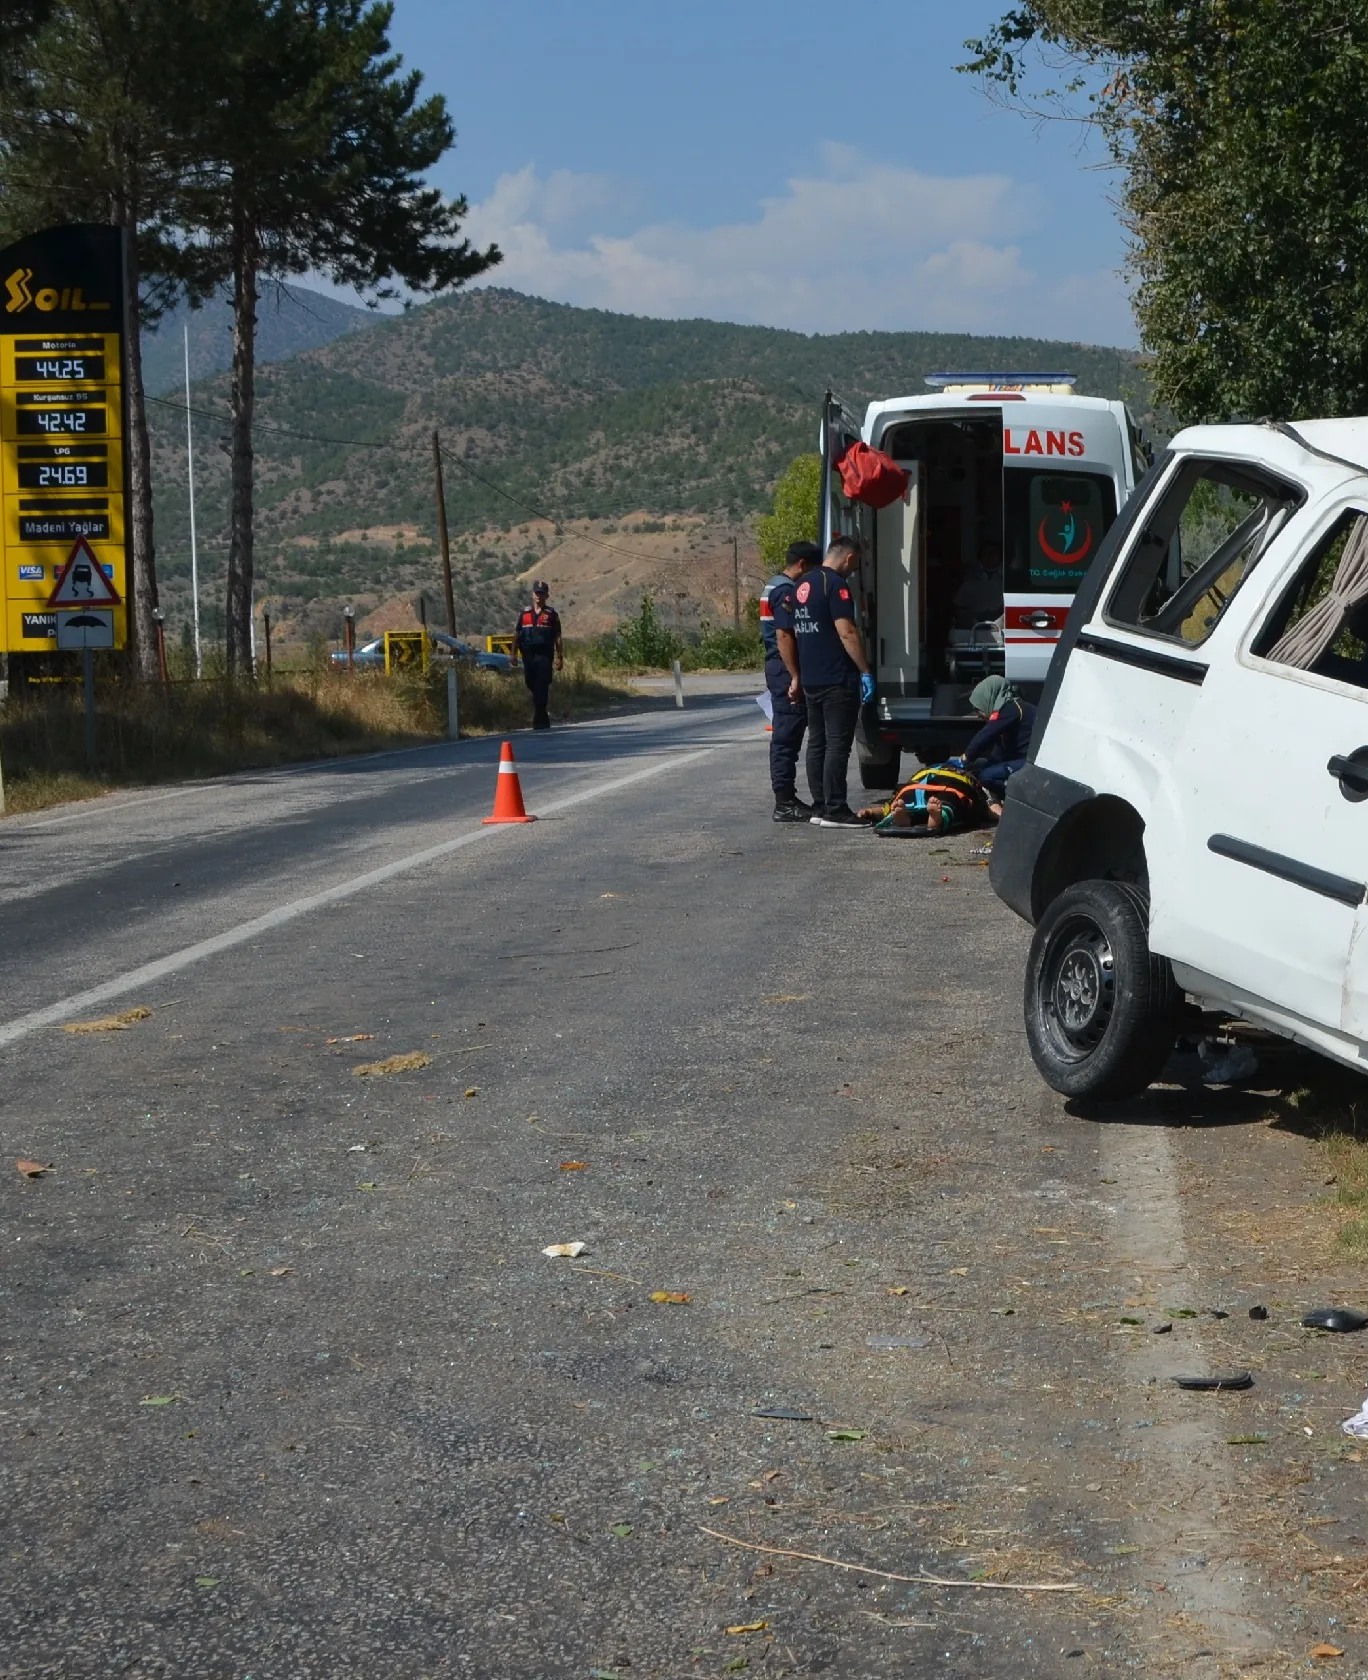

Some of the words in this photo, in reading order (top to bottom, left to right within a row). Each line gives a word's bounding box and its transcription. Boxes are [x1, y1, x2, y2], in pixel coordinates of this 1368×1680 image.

[42, 342, 76, 350] Motorin
[36, 360, 84, 379] 44.25
[76, 393, 88, 401] 95
[38, 413, 86, 431] 42.42
[1004, 428, 1085, 456] LANS
[54, 447, 71, 455] LPG
[39, 466, 87, 485] 24.69
[25, 522, 65, 533] Madeni
[68, 521, 105, 535] Yağlar
[20, 566, 42, 574] VISA
[793, 620, 819, 634] AĞLIK
